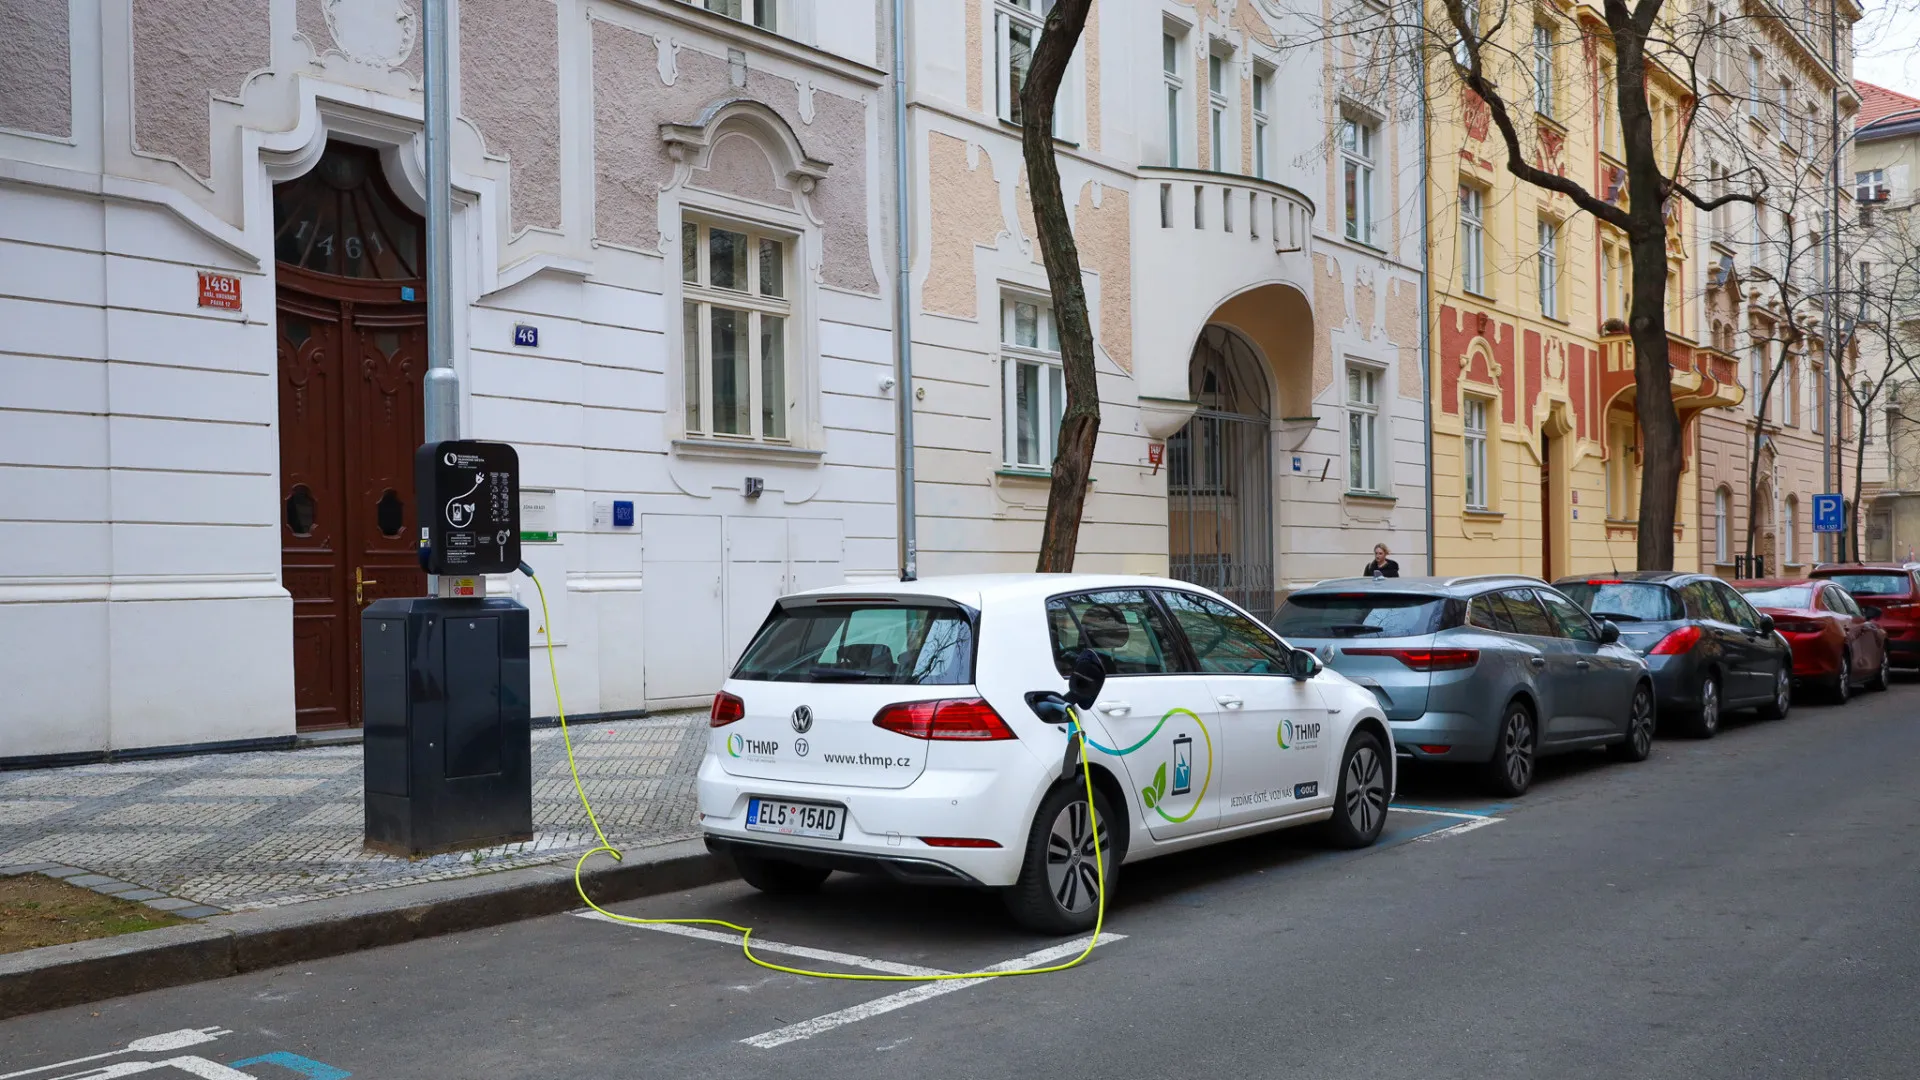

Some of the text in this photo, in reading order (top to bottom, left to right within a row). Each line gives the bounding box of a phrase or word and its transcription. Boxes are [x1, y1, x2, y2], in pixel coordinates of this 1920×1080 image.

[296, 220, 384, 259] 1461
[205, 276, 236, 293] 1461
[518, 329, 535, 343] 46
[1820, 499, 1836, 520] P
[1295, 723, 1321, 740] THMP
[746, 739, 779, 755] THMP
[797, 742, 807, 753] 77
[824, 752, 911, 769] www.thmp.cz
[749, 815, 757, 823] CZ
[760, 803, 836, 831] EL5 15AD
